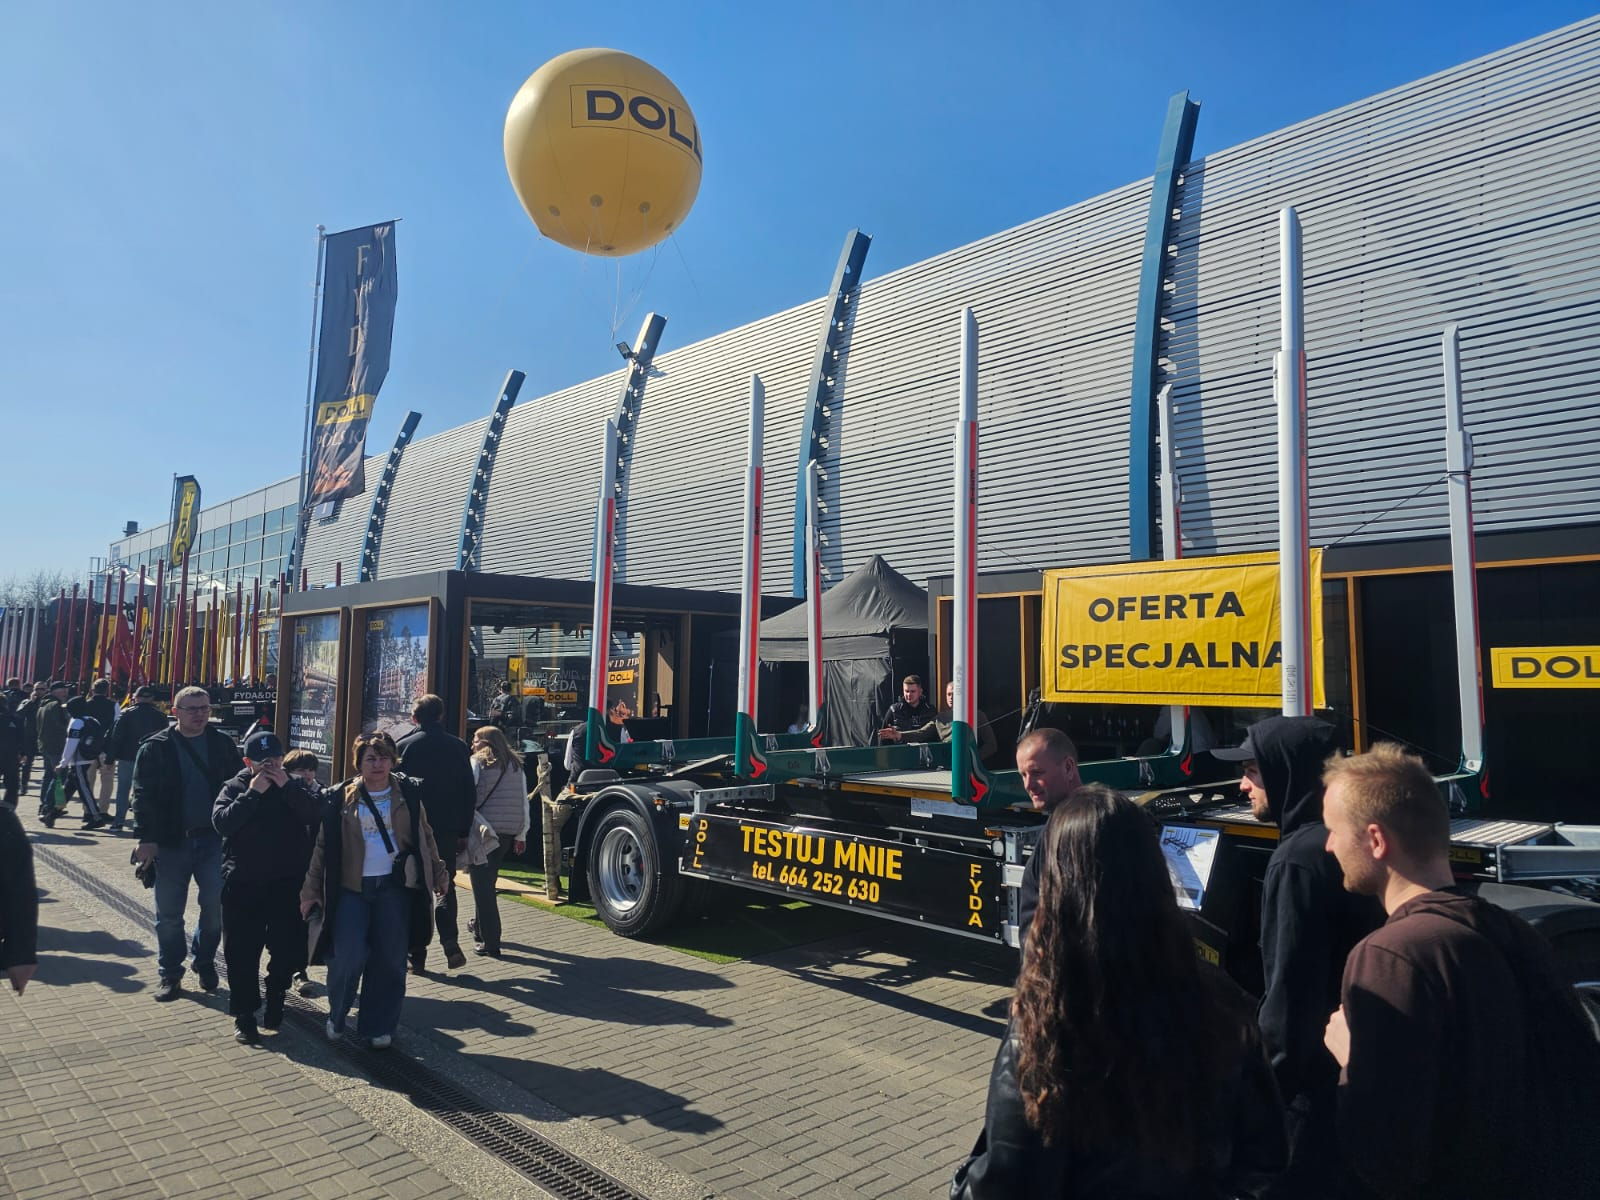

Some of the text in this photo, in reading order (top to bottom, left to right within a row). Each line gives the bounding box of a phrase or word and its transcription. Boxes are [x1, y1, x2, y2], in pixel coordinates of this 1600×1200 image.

[1088, 591, 1246, 622] OFERTA
[609, 672, 631, 682] DOLL
[1060, 641, 1283, 669] SPECJALNA
[692, 819, 708, 869] DOLL
[740, 825, 904, 881] TESTUJ MNIE
[752, 860, 880, 904] tel. 664 252 630
[968, 863, 983, 928] FYDA
